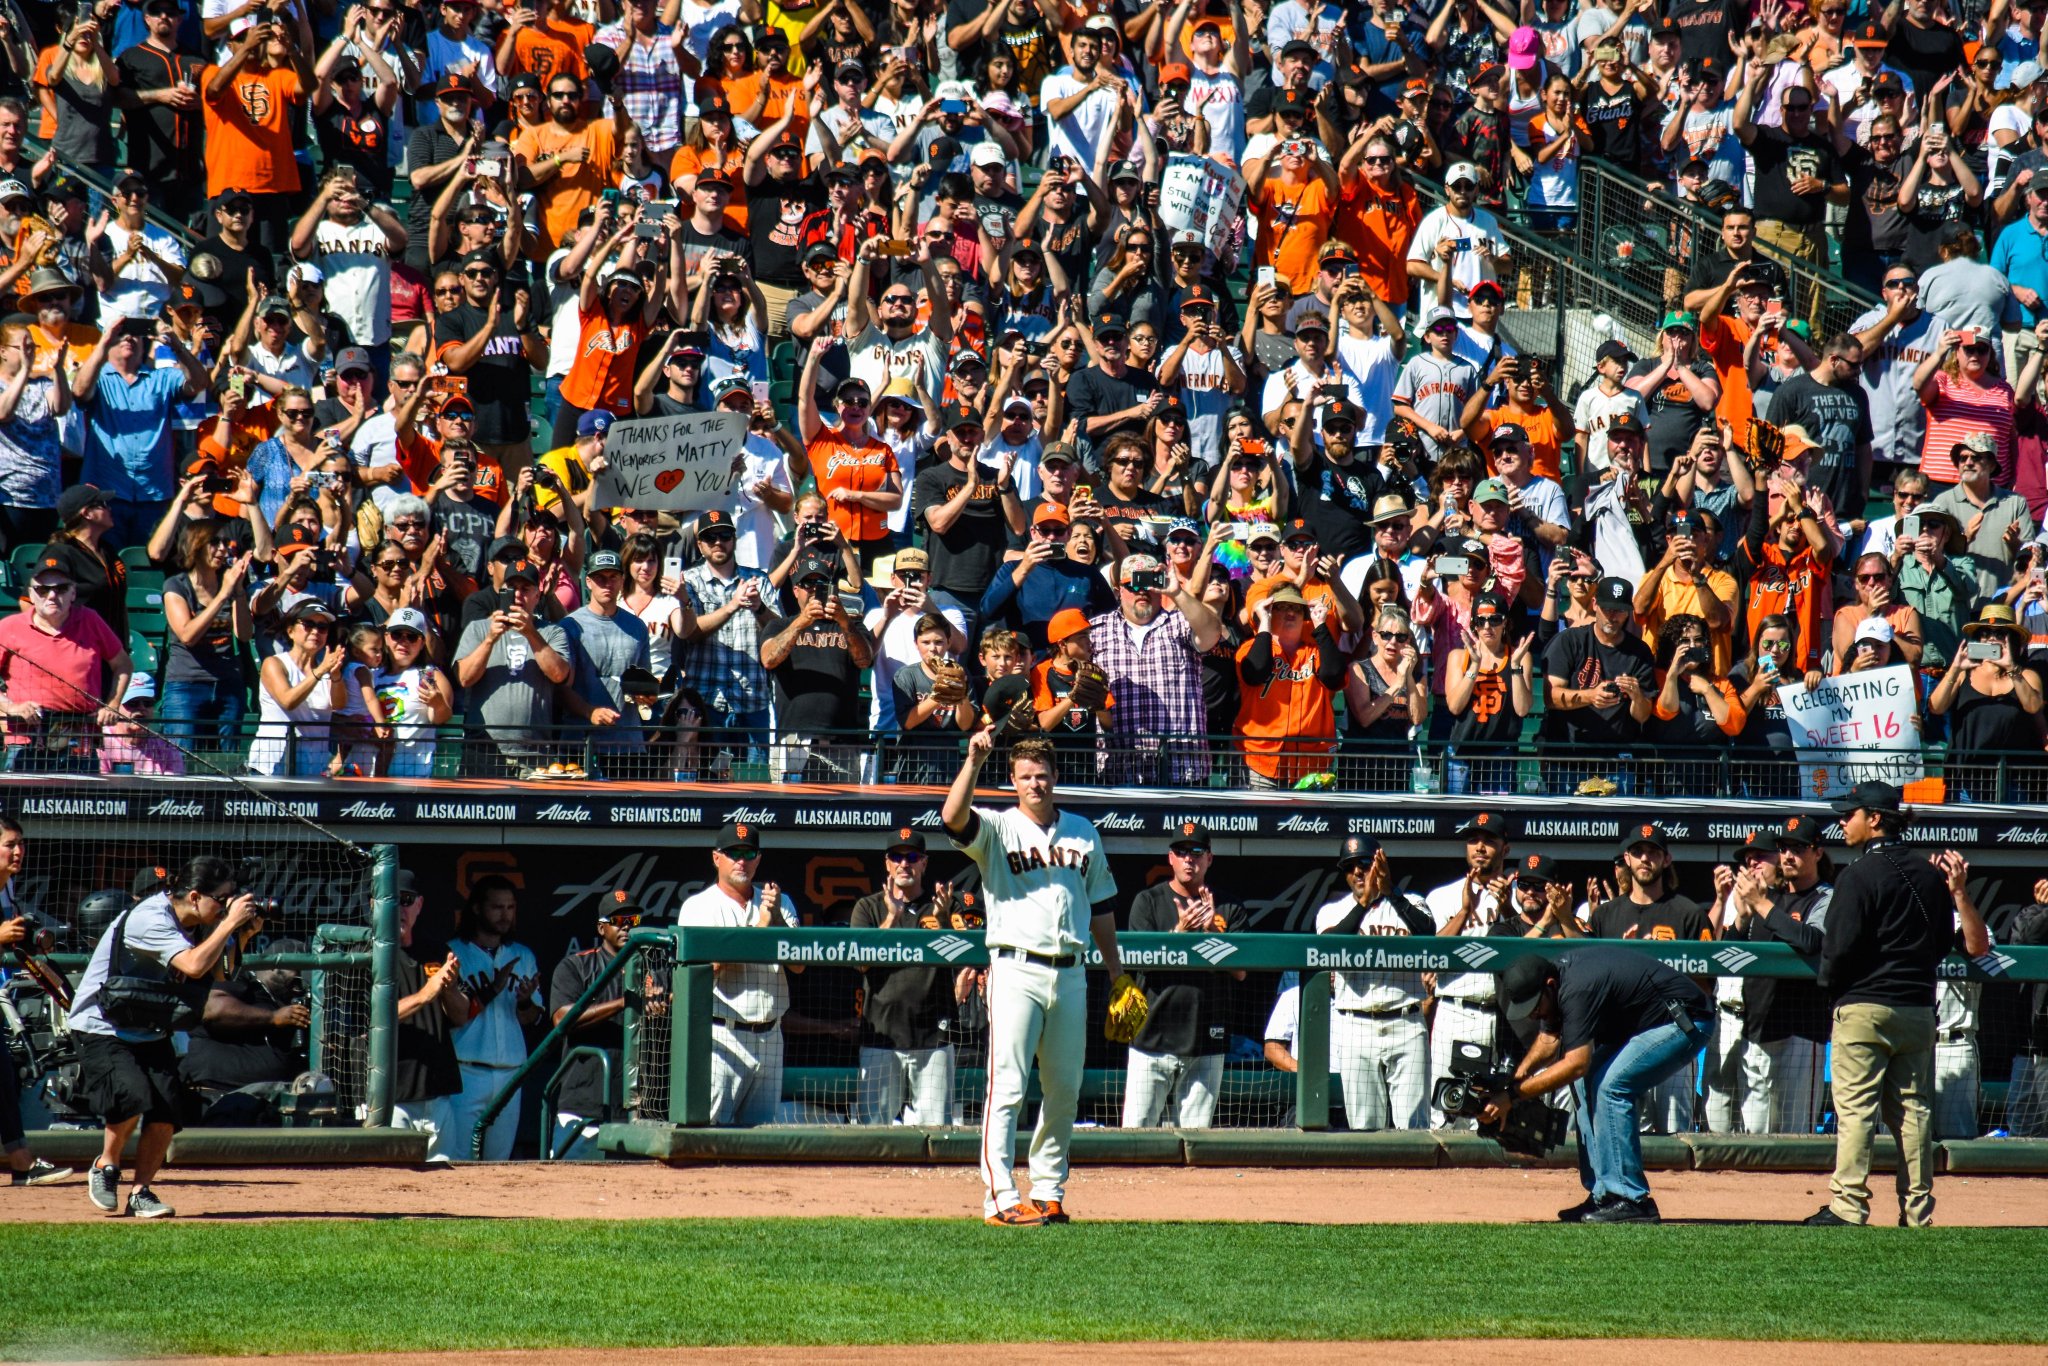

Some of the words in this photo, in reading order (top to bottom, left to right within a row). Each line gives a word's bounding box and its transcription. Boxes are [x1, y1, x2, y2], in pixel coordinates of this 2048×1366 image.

[1167, 186, 1192, 202] STILL
[484, 335, 520, 356] ANT
[616, 424, 669, 446] THANKS
[673, 422, 694, 439] FOR
[700, 418, 727, 432] THE
[609, 449, 666, 471] MEMORIES
[676, 438, 733, 463] MATTY
[614, 473, 651, 498] WE
[694, 469, 735, 496] YOU!
[796, 630, 849, 651] IANTS
[1792, 677, 1900, 712] CELEBRATING
[1832, 705, 1854, 722] MY
[1806, 722, 1863, 749] SWEET
[1873, 711, 1900, 740] 16
[1837, 753, 1919, 787] GIANTS
[22, 799, 127, 816] ALASKAAIR.COM
[225, 802, 319, 818] SFGIANTS.COM
[416, 804, 516, 821] ALASKAAIR.COM
[611, 808, 702, 823] SFGIANTS.COM
[795, 811, 892, 827] ALASKAAIR.COM
[911, 810, 942, 827] Ala
[1348, 819, 1435, 836] SFGIANTS.COM
[1525, 822, 1619, 837] ALASKAAIR.COM
[1007, 845, 1090, 878] GIANTS
[777, 941, 826, 965] Bank
[827, 941, 847, 965] of
[848, 944, 924, 966] America
[1306, 947, 1350, 969] Bank
[1352, 948, 1372, 970] of
[1374, 950, 1449, 971] America
